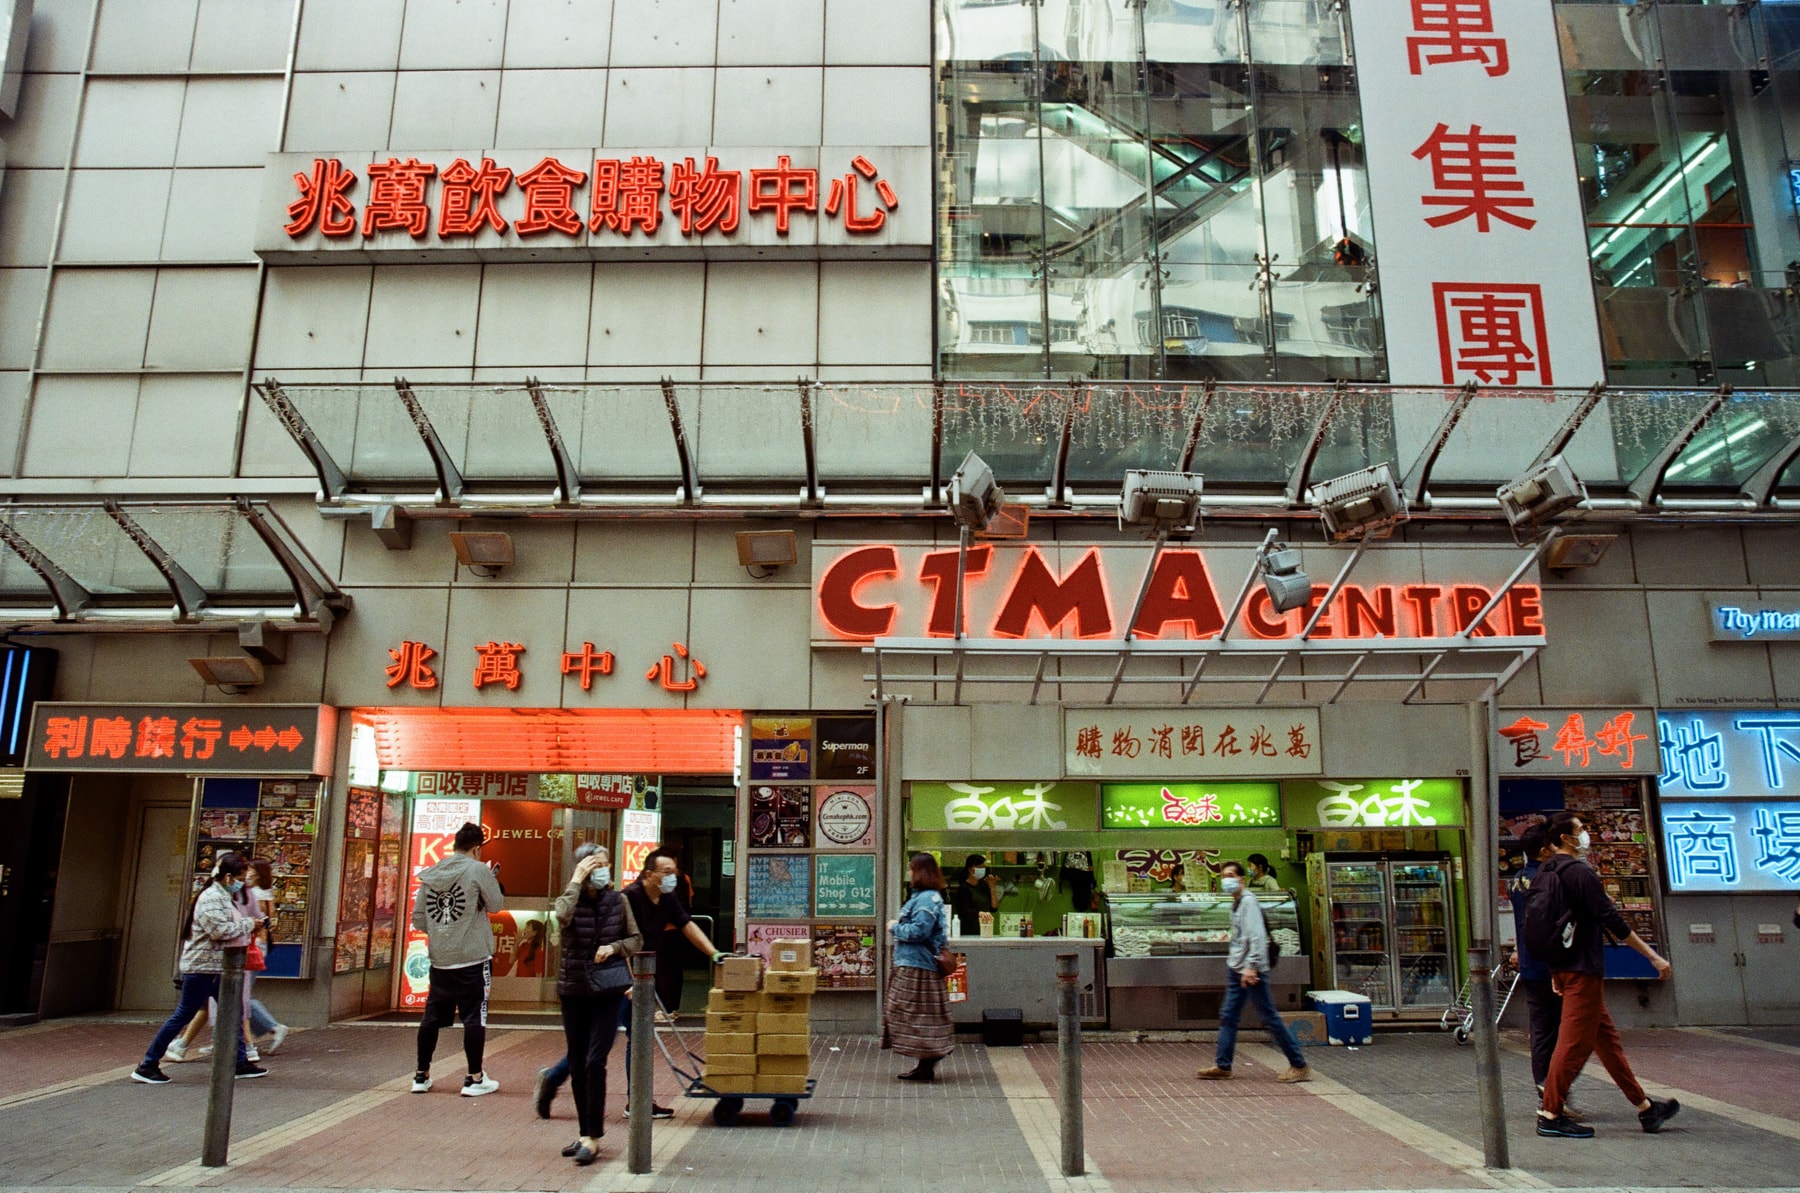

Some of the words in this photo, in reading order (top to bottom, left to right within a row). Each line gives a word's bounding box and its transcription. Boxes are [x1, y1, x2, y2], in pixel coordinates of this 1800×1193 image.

[282, 155, 899, 239] 兆萬飲食購物中心
[817, 544, 1227, 640] CTMA
[1245, 584, 1546, 640] CENTRE
[384, 640, 707, 691] 兆萬中心
[822, 740, 869, 752] Superman
[1498, 711, 1648, 769] 食得好
[1657, 718, 1800, 791] 地下
[856, 766, 869, 775] 2F
[417, 772, 528, 796] 回收專門店
[577, 774, 633, 794] 回收專門店
[493, 829, 542, 839] JEWEL
[1664, 811, 1800, 885] 商場
[819, 863, 828, 873] IT
[819, 875, 856, 886] Mobile
[819, 888, 847, 899] Shop
[851, 888, 872, 898] G12
[765, 927, 808, 937] CHUSIER
